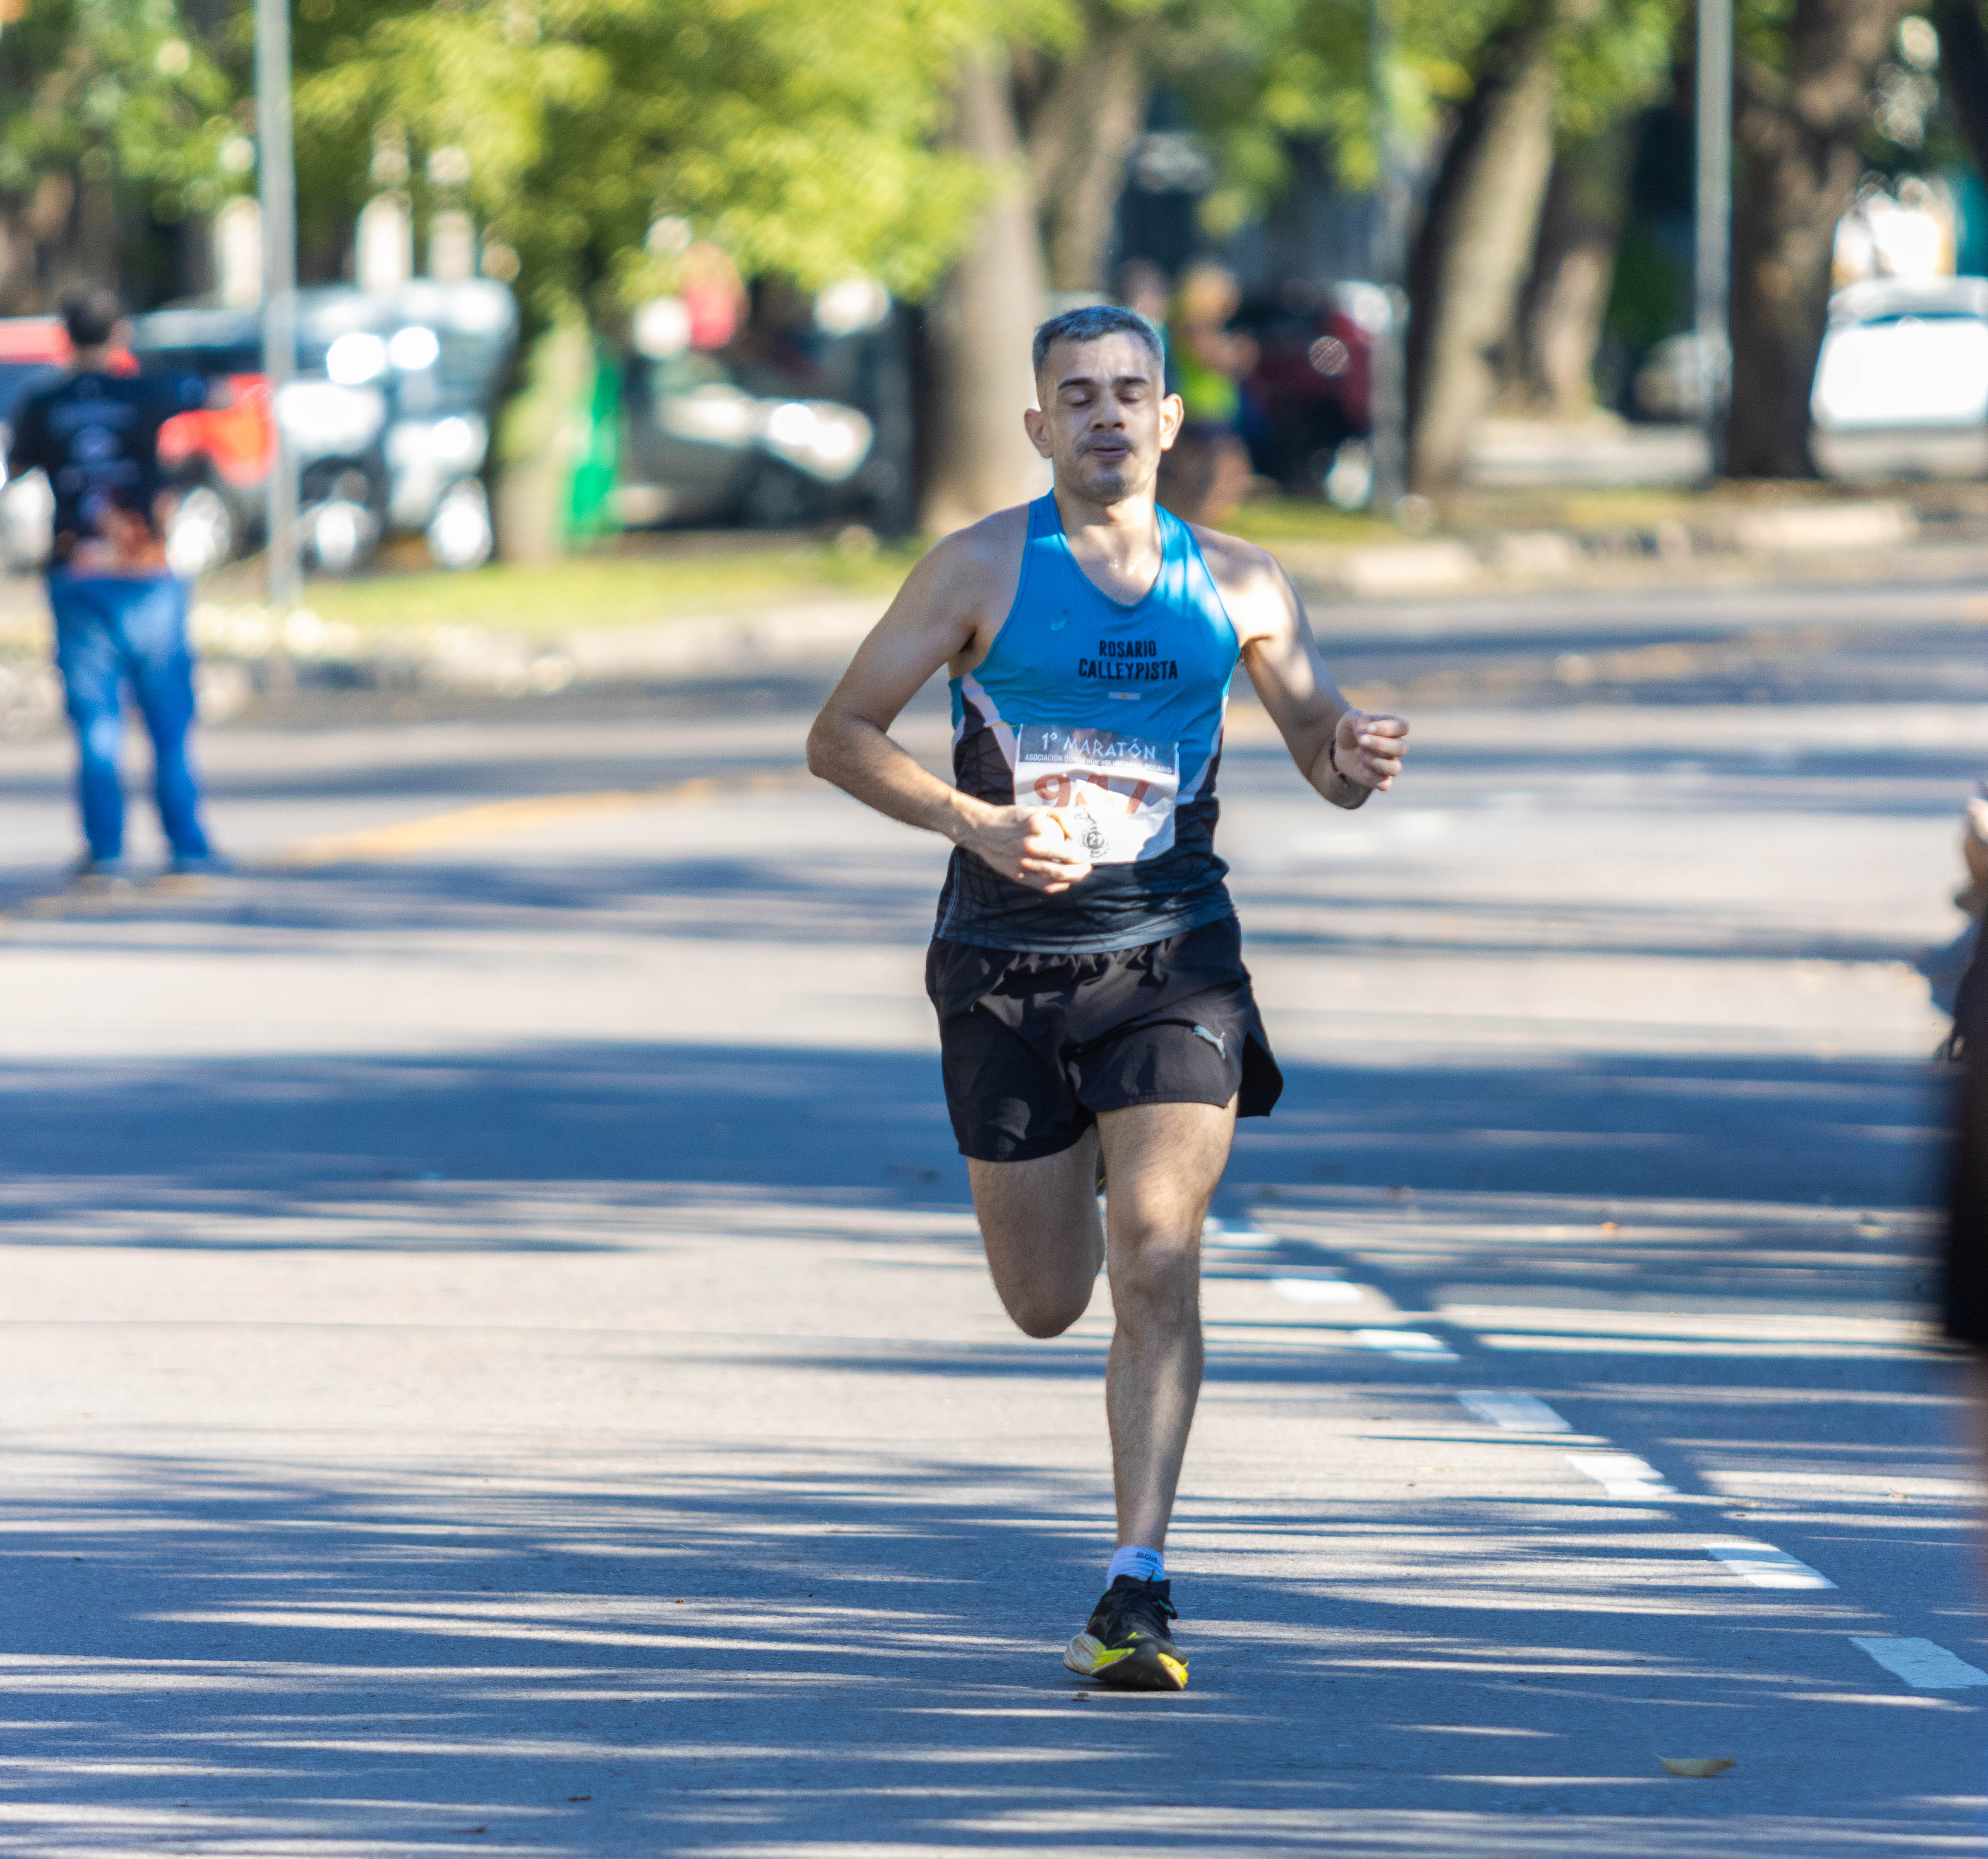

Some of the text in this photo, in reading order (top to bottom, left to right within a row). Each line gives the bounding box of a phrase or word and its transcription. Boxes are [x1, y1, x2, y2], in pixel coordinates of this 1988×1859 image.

[1099, 639, 1157, 658] ROSARIO
[1079, 658, 1178, 680] CALLEYPISTA
[1063, 735, 1156, 760] MARATÓN
[1025, 753, 1063, 762] ASOCIACIÓN
[1144, 763, 1173, 774] ROSARIO
